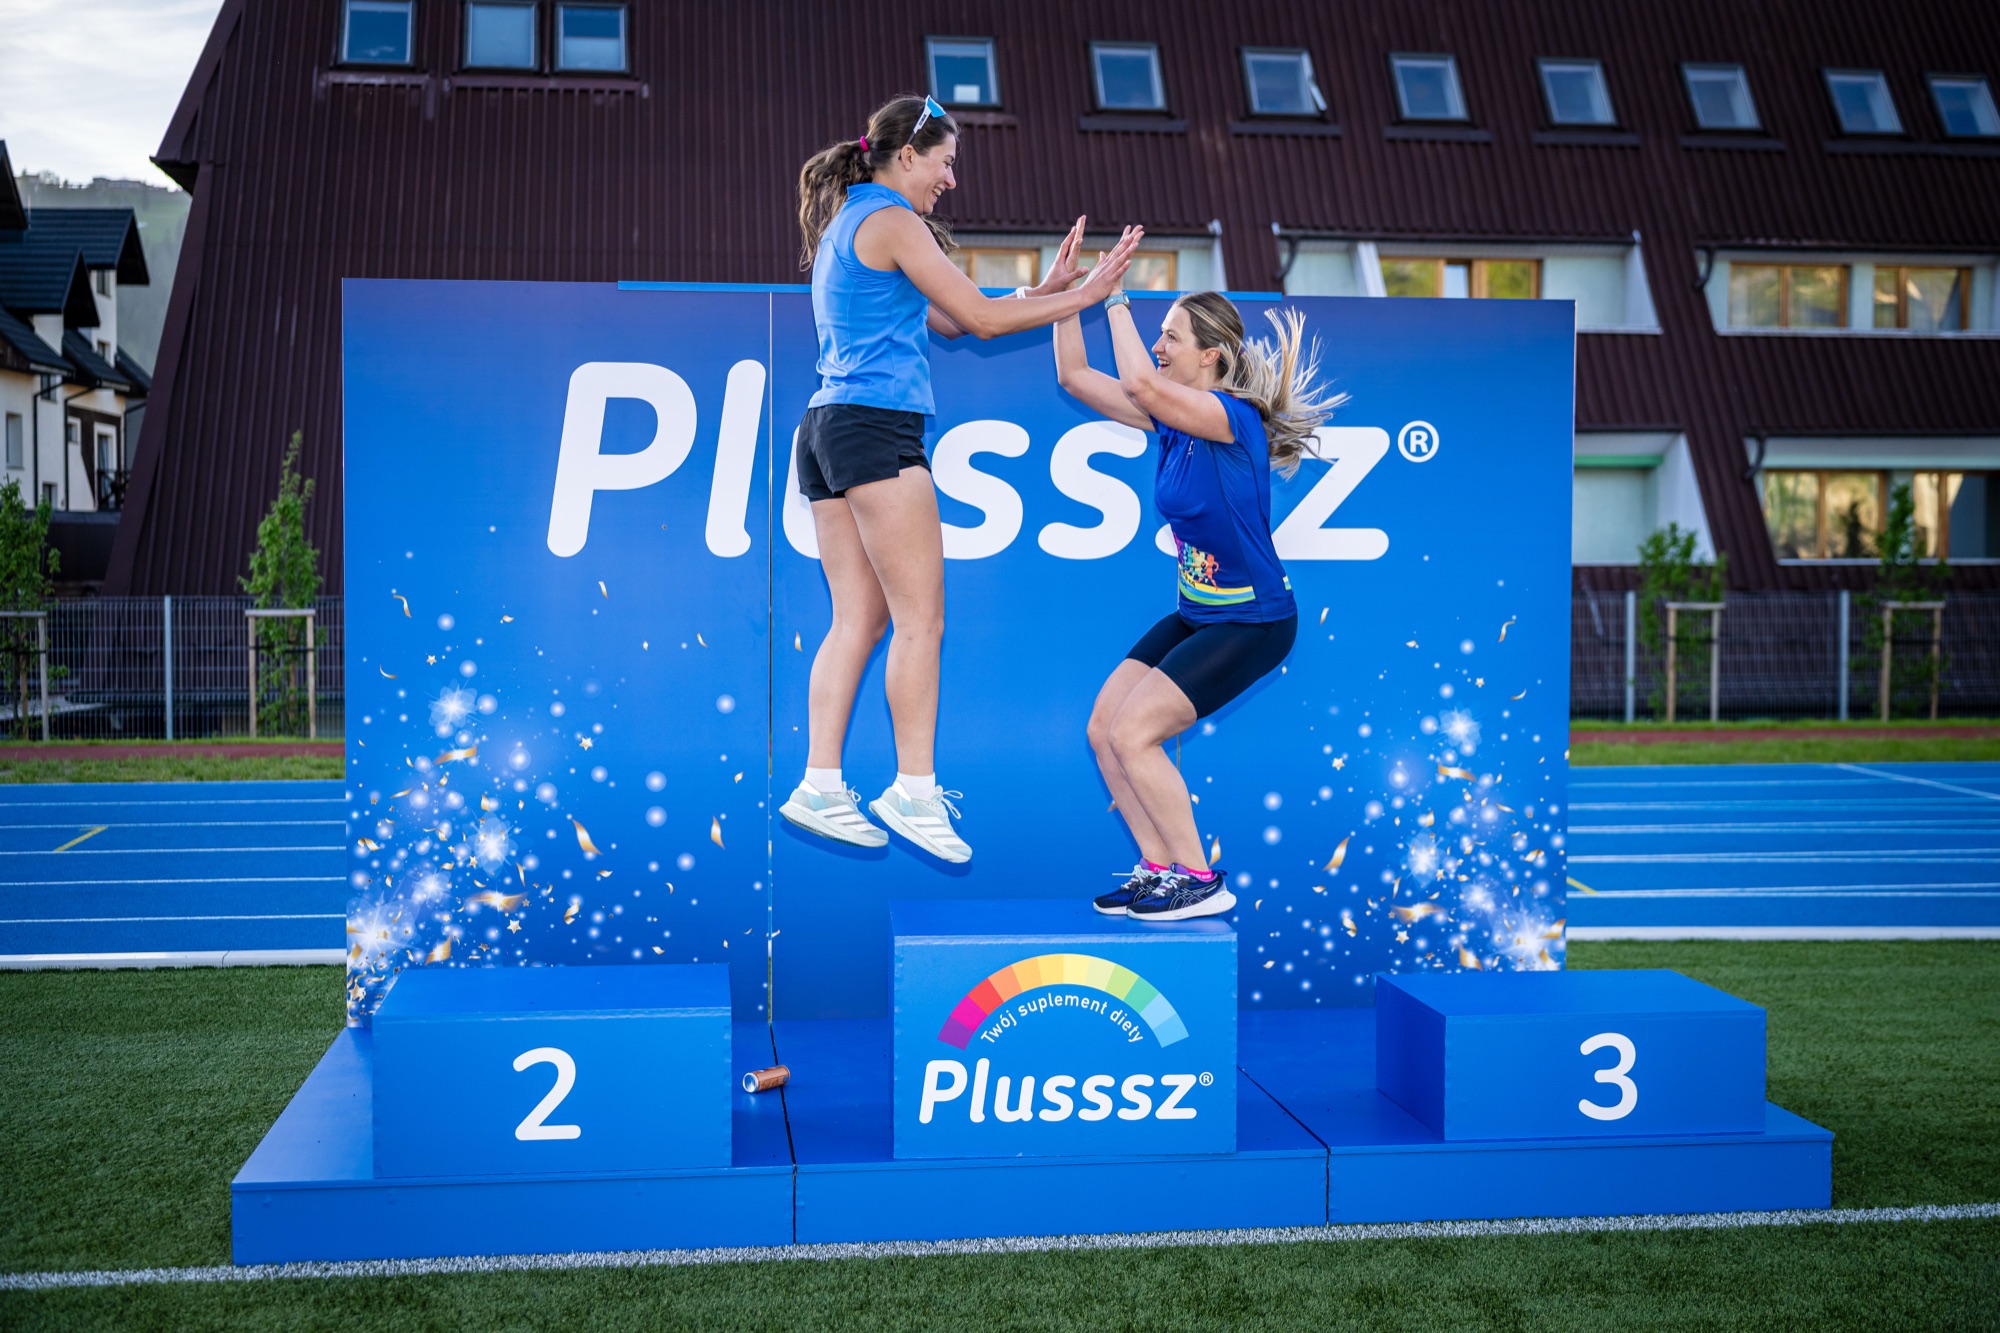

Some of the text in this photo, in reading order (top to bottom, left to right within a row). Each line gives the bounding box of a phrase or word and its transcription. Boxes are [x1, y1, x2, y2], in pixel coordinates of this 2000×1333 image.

[980, 992, 1144, 1043] Twój suplement diety
[512, 1047, 582, 1141] 2
[1578, 1032, 1638, 1121] 3
